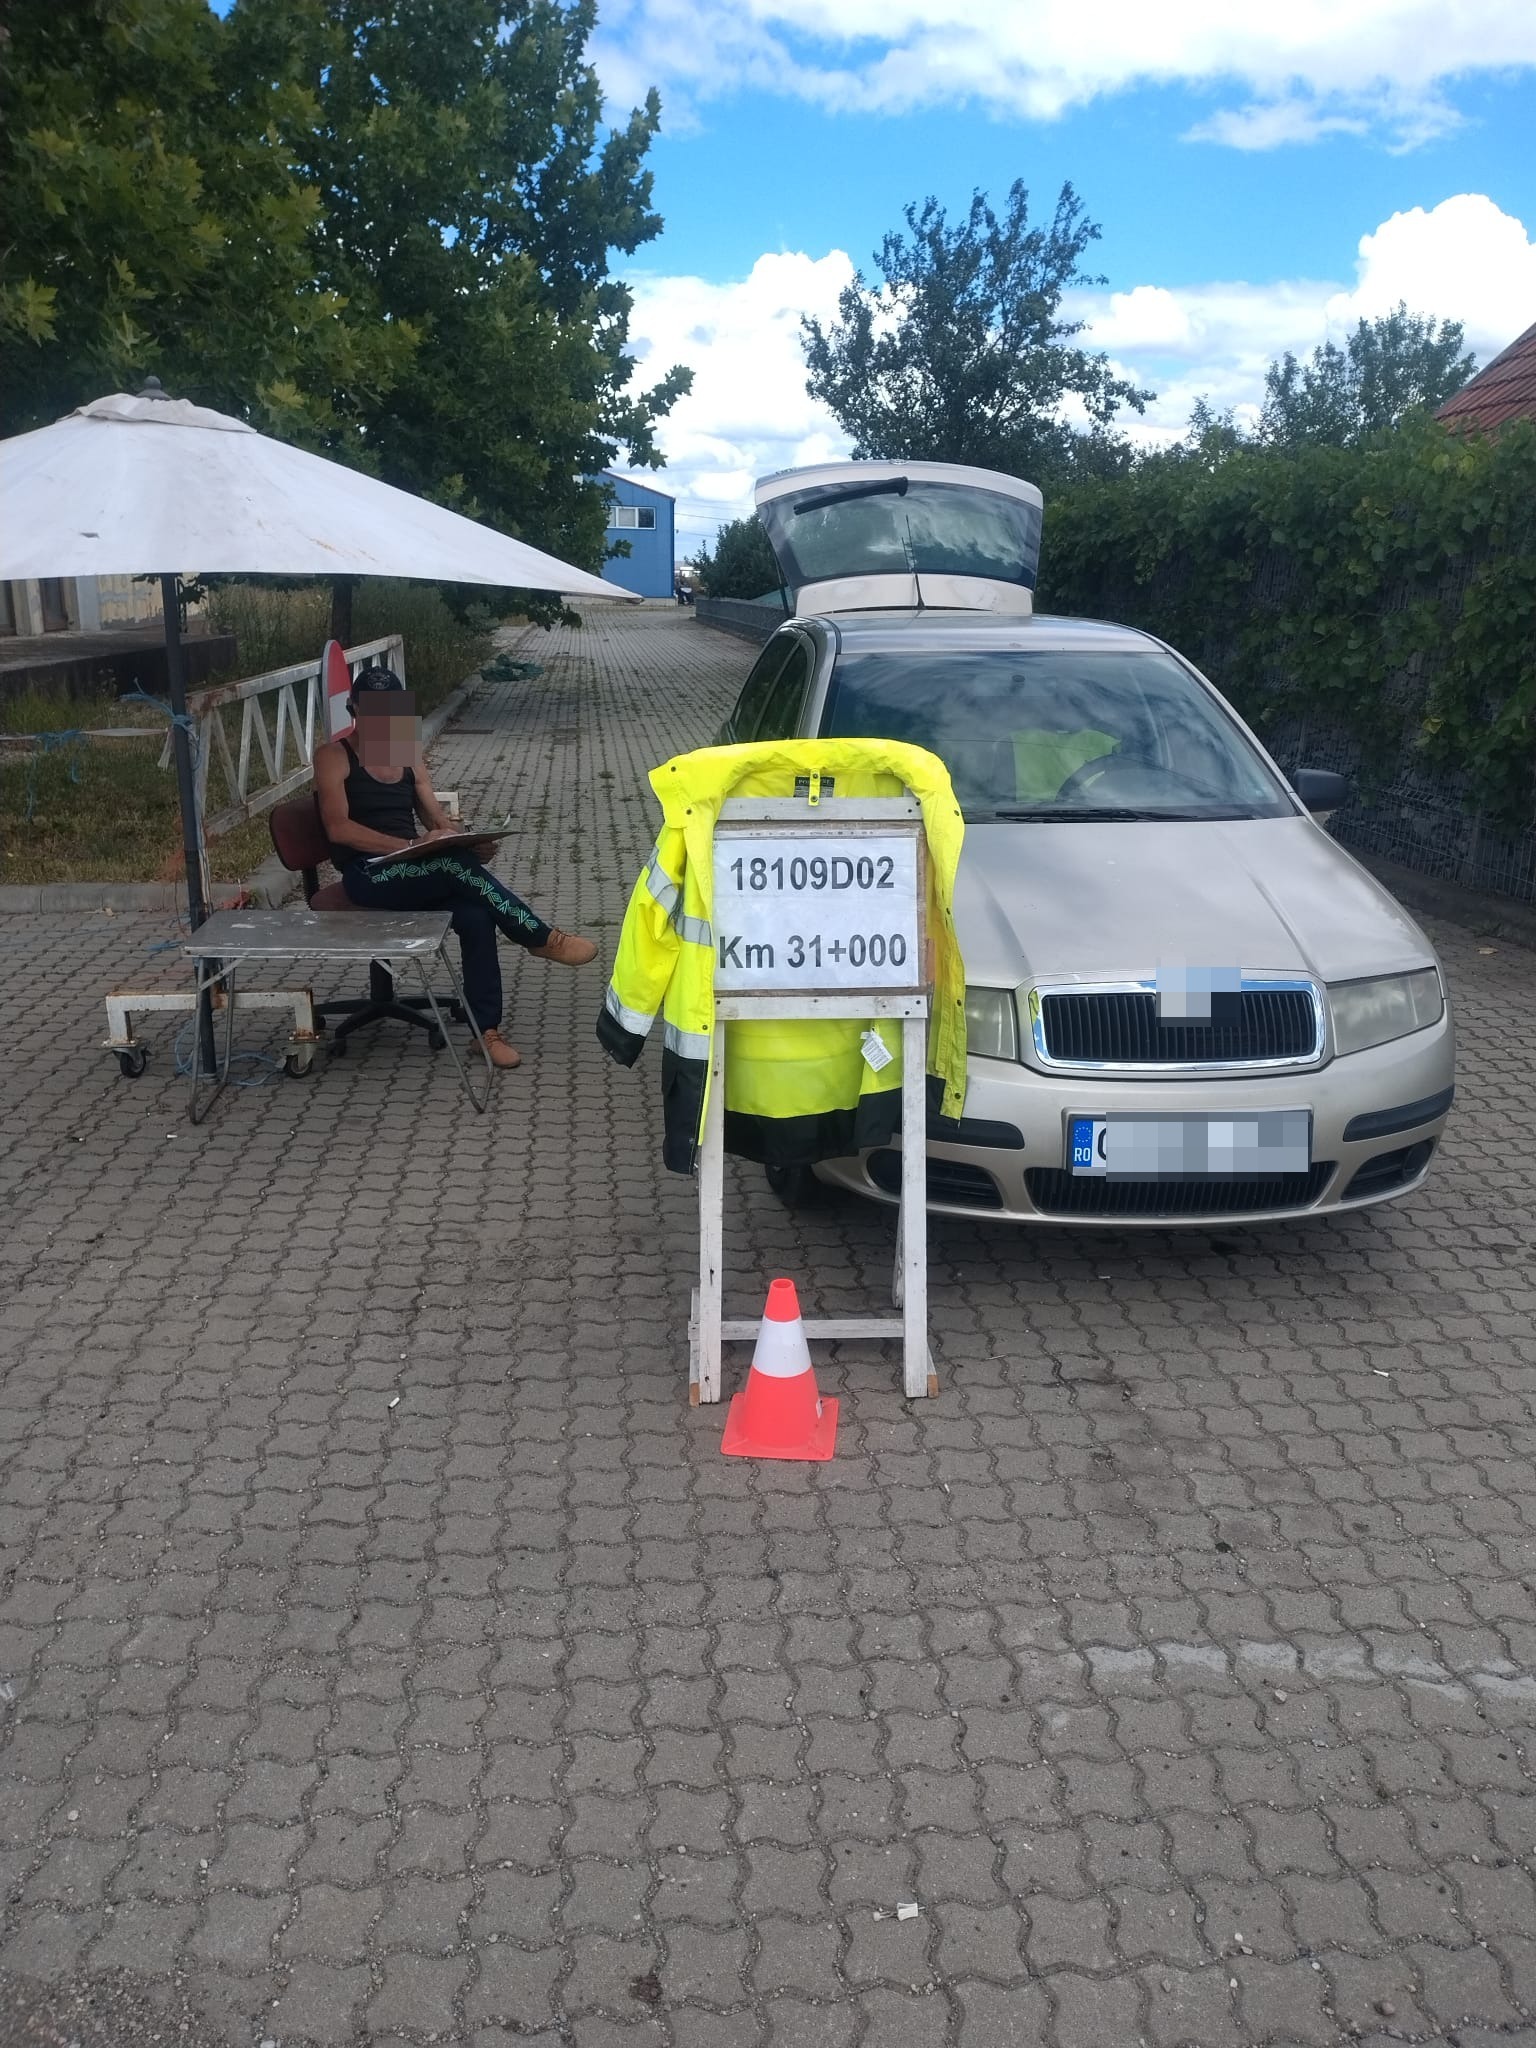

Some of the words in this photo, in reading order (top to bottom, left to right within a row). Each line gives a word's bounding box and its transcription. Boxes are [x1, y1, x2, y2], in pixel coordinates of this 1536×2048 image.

[730, 856, 895, 891] 18109D02
[719, 935, 775, 969] Km
[787, 933, 907, 969] 31+000
[1074, 1147, 1091, 1162] RO
